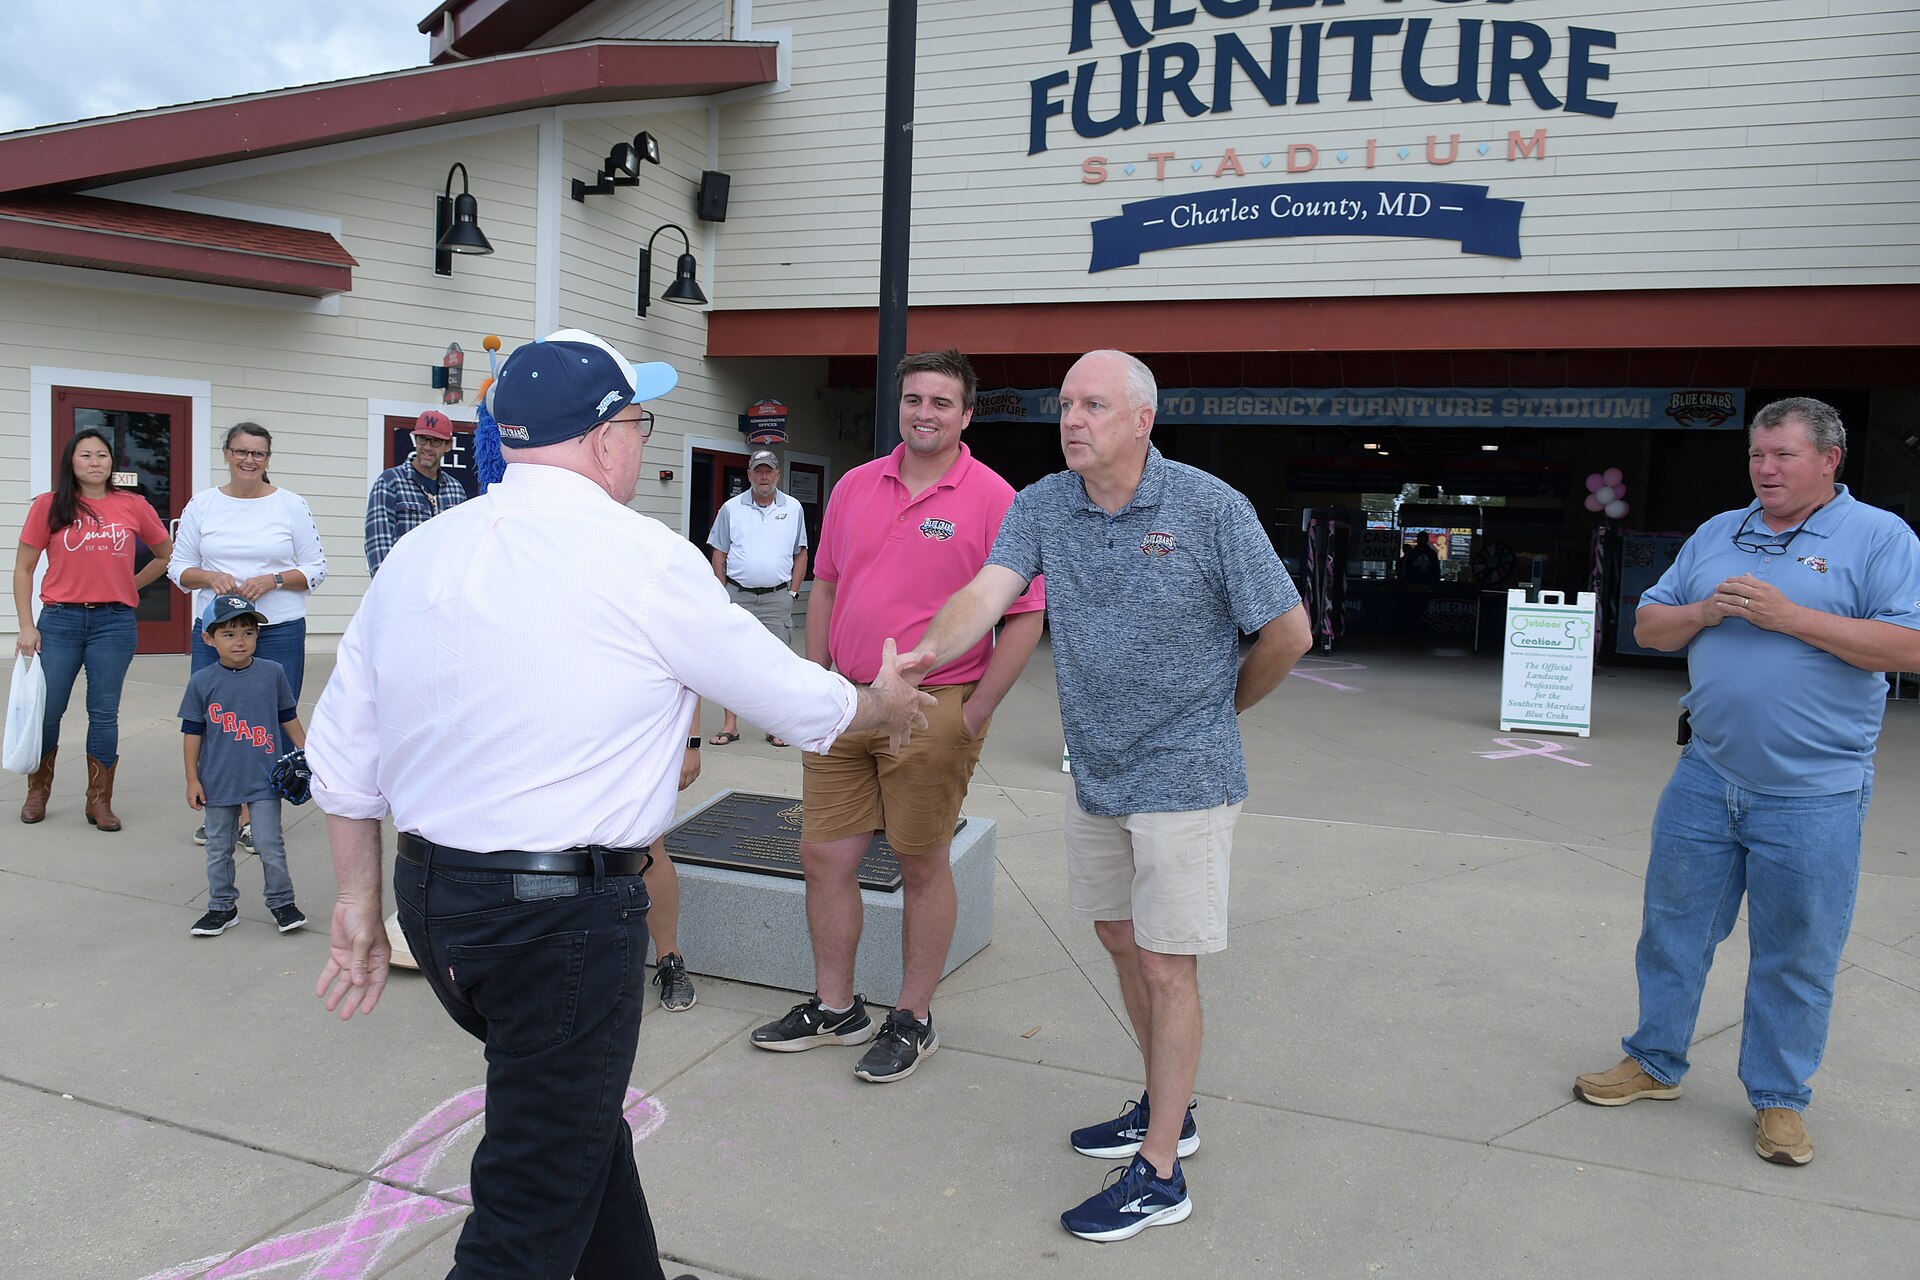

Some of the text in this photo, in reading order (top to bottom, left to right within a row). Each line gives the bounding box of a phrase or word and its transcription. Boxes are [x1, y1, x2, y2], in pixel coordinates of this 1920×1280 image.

[1027, 17, 1618, 157] FURNITURE
[1081, 129, 1548, 185] STADIUM
[1170, 192, 1431, 229] Charles County, MD
[976, 394, 1024, 407] REGENCY
[1671, 392, 1732, 409] BLUE CRABS
[1163, 396, 1650, 418] TO REGENCY FURNITURE STADIUM!
[425, 416, 438, 428] W
[111, 474, 136, 484] EXIT
[64, 519, 129, 552] County
[1364, 532, 1399, 544] CASH
[1363, 547, 1398, 558] ONLY
[1511, 615, 1561, 630] Outdoor
[1510, 631, 1562, 649] Creations
[1525, 662, 1572, 672] The Official
[1527, 672, 1569, 681] Landscape
[1524, 681, 1573, 691] Professional
[1534, 691, 1561, 700] for the
[1508, 700, 1586, 712] Southern Maryland
[1525, 710, 1569, 720] Blue Crabs
[208, 703, 276, 755] CRABS
